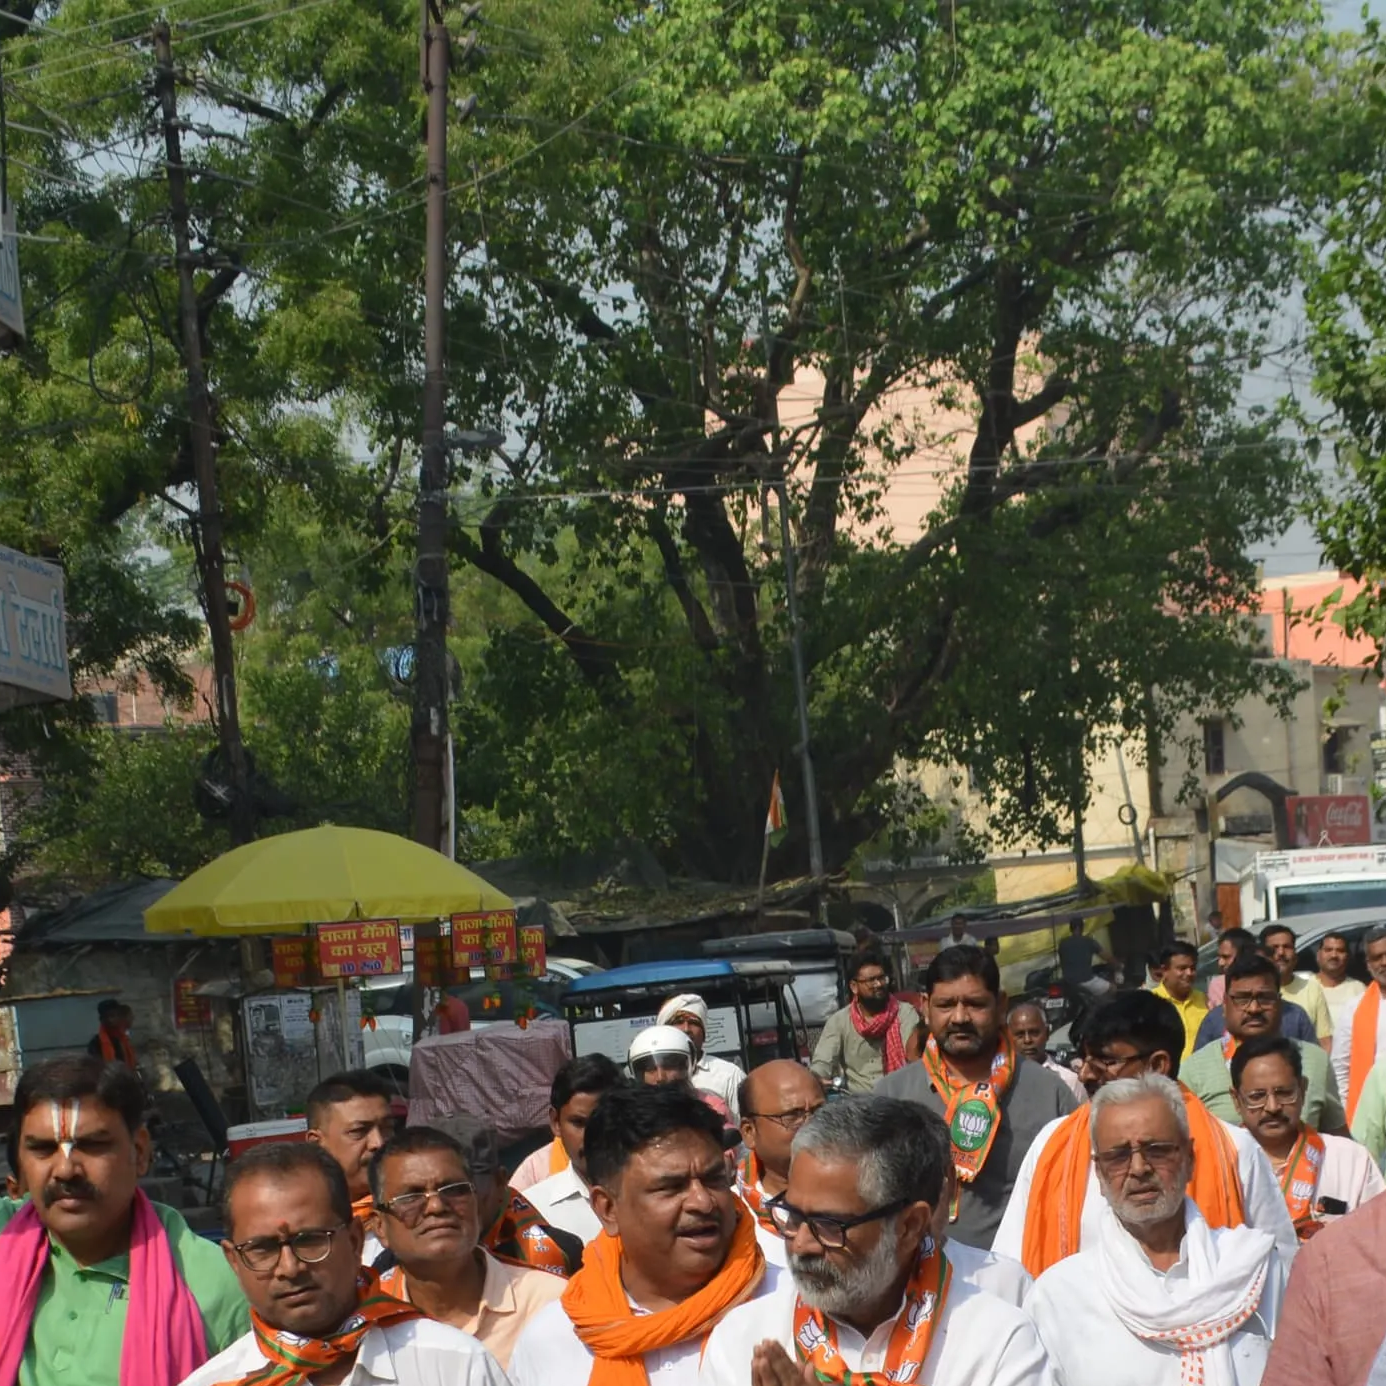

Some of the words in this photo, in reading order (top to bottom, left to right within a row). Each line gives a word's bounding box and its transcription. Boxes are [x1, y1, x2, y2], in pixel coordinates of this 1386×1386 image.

[319, 928, 358, 943] ताजा
[361, 922, 396, 939] मैंगो
[460, 933, 480, 945] का
[330, 944, 354, 957] का
[357, 941, 388, 959] जूस
